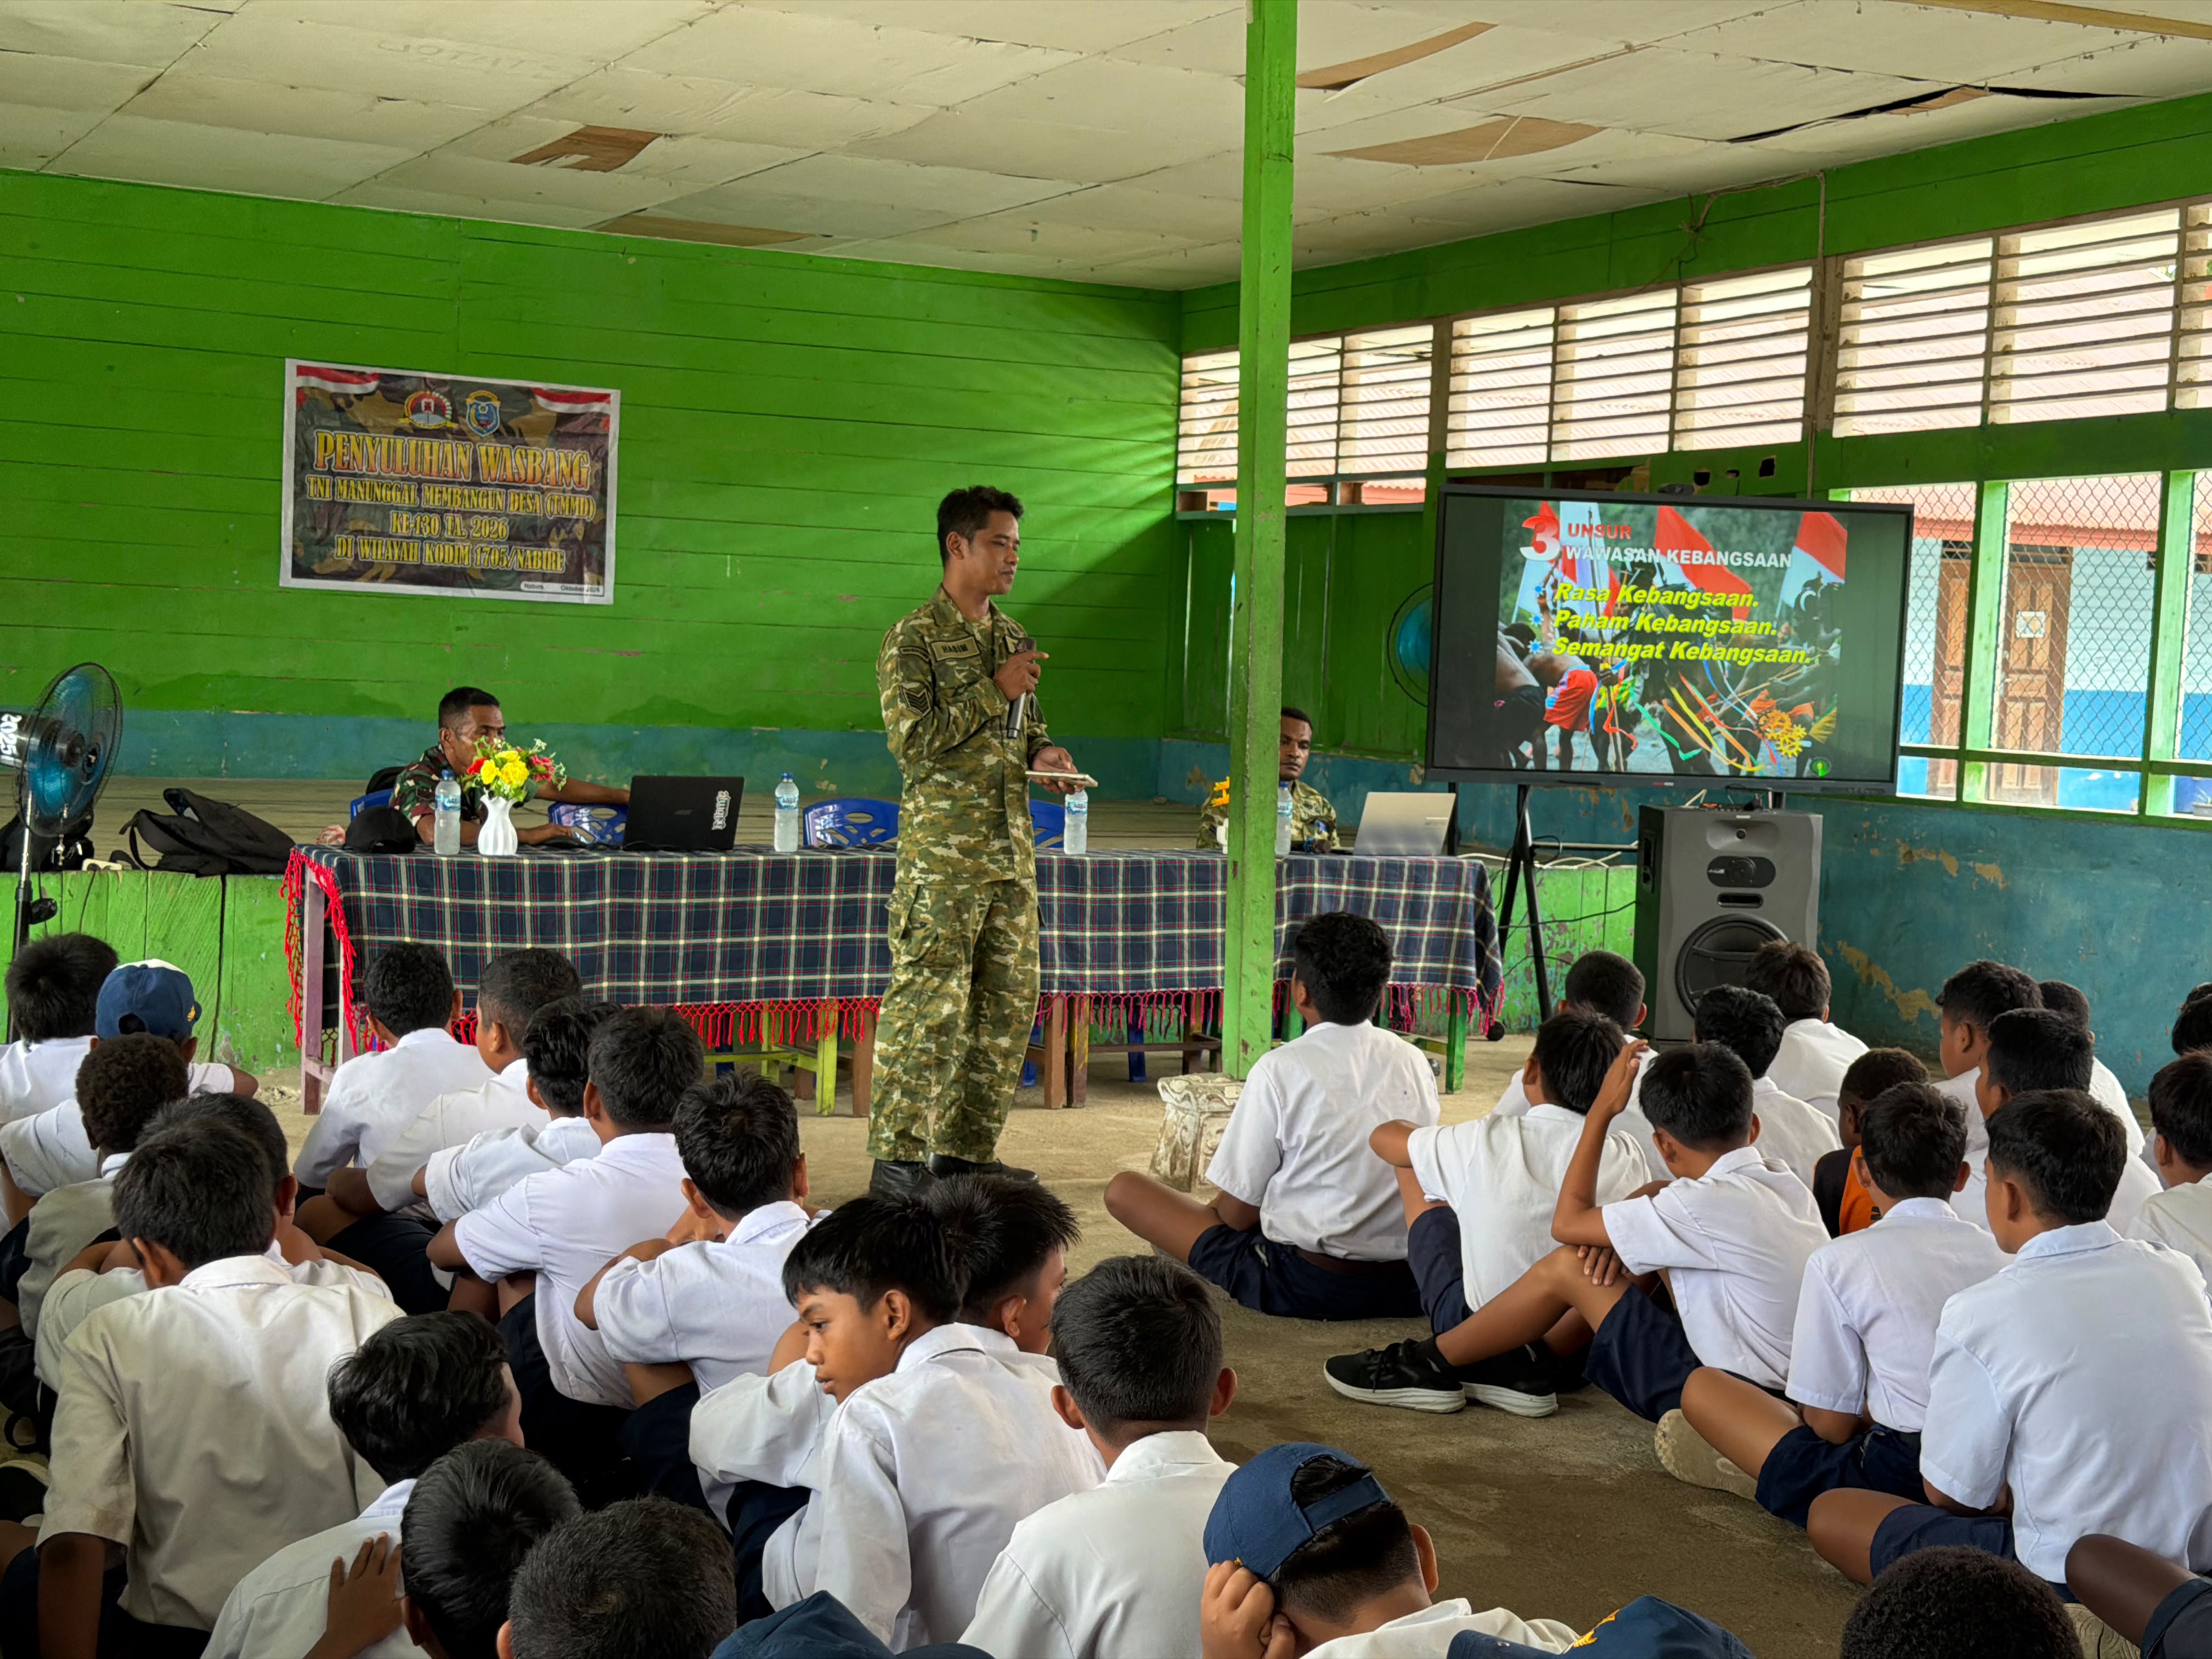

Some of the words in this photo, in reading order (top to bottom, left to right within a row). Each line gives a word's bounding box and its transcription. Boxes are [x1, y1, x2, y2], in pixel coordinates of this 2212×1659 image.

[315, 431, 472, 481] PENYULUHAN
[478, 443, 590, 489] WASBANG
[307, 476, 331, 499] TNI
[336, 478, 417, 505] MANUNGGAL
[422, 484, 505, 511] MEMBANGUN
[508, 490, 541, 514] DESA
[546, 494, 595, 521] (TMMD)
[391, 511, 440, 537] KE-130
[445, 514, 466, 537] TA.
[471, 516, 508, 540] 2026
[1520, 516, 1560, 561] 3
[1568, 523, 1632, 539] UNSUR
[335, 535, 353, 558] DI
[358, 537, 420, 563] WILAYAH
[424, 541, 471, 566] KODIM
[475, 545, 565, 572] 1705/NABIRE
[1566, 545, 1661, 562] WAWASAN
[1667, 549, 1792, 568] KEBANGSAAN
[1554, 583, 1611, 601] Rasa
[1617, 584, 1759, 610] Kebangsaan.
[1554, 610, 1629, 630] Paham
[1635, 612, 1777, 637] Kebangsaan.
[1553, 637, 1665, 662] Semangat
[1669, 641, 1810, 666] Kebangsaan.
